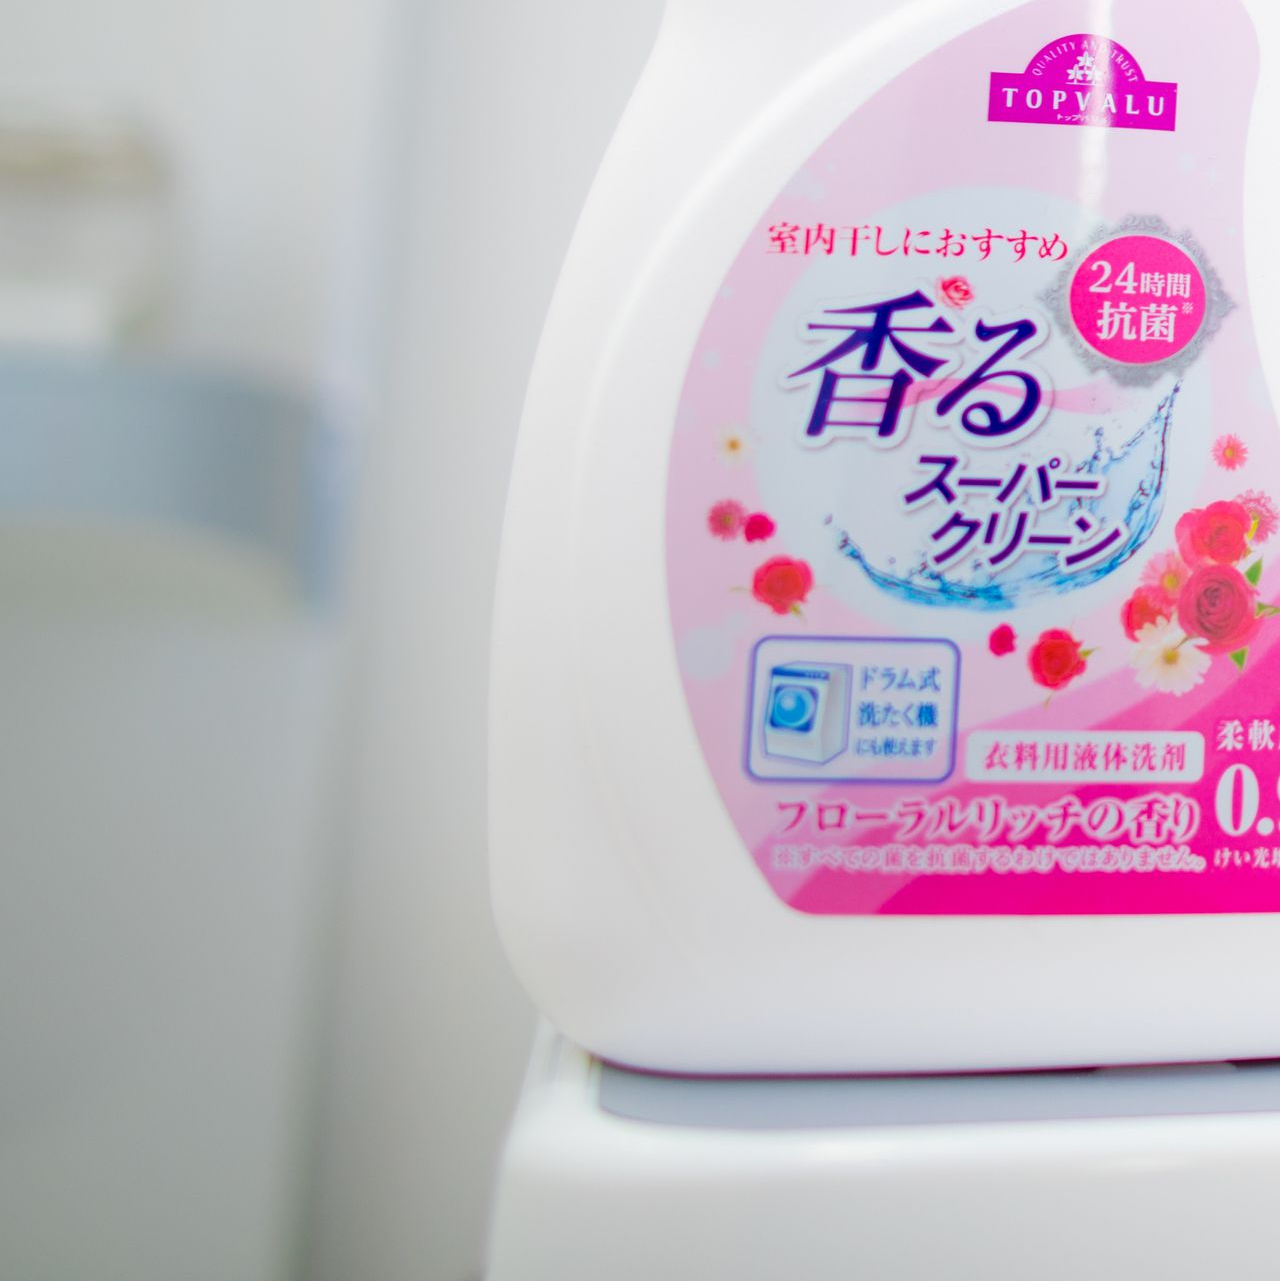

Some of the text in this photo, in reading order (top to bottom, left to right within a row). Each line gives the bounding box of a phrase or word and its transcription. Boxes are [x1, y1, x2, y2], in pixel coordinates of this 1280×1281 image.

[1032, 41, 1076, 76] QUALITY
[1110, 49, 1138, 82] TRUST
[1002, 87, 1164, 116] TOPVALU
[766, 222, 1068, 262] 室内干しにおすすめ
[1089, 260, 1191, 298] 24時間
[787, 289, 1041, 437] 香る
[904, 455, 1099, 504] スーパー
[932, 511, 1121, 566] クリーン
[861, 665, 941, 692] ドラム式
[859, 701, 938, 727] 洗たく機
[856, 737, 937, 756] にも使えます
[983, 742, 1186, 771] 衣料用液体洗剤
[777, 797, 1200, 841] フローラルリッチの香り
